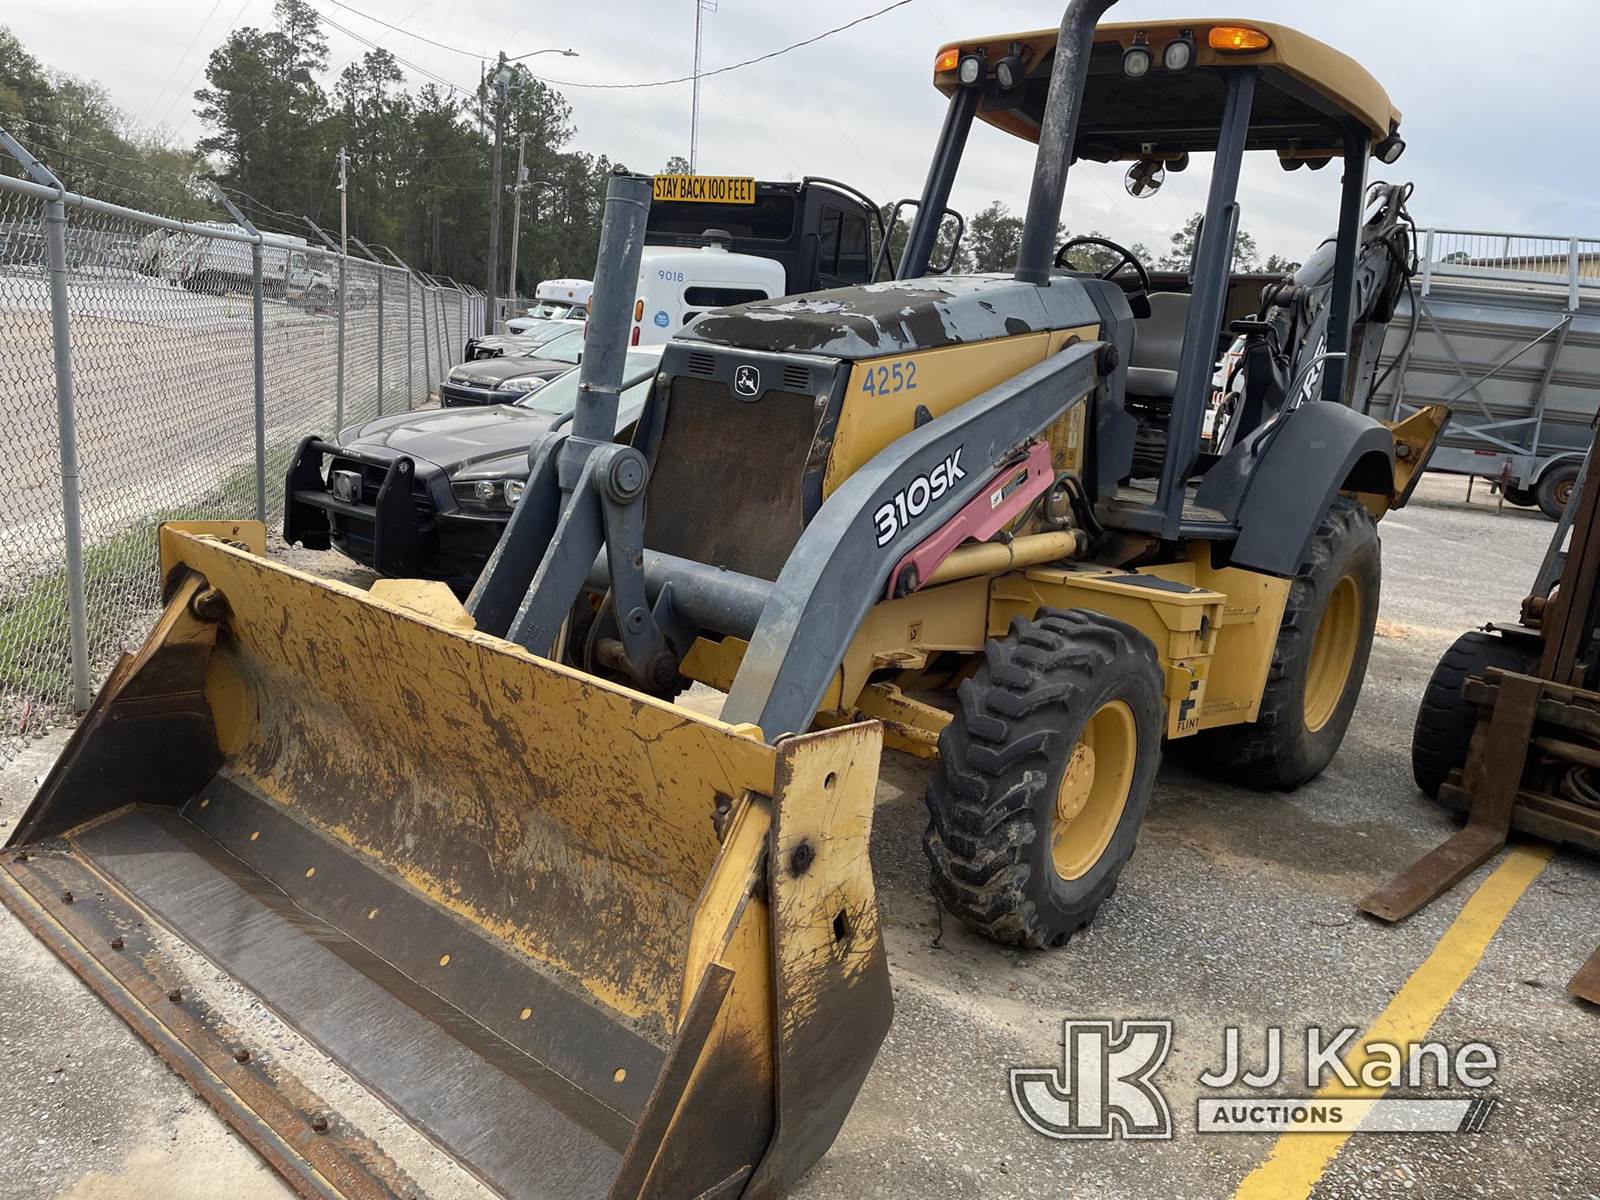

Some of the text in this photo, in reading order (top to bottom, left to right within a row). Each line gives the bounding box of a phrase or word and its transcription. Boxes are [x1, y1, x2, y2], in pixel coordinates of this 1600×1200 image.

[655, 177, 753, 201] STAY BACK 100 FEET
[658, 270, 684, 282] 9018
[863, 361, 917, 397] 4252
[873, 445, 967, 548] 310SK
[1177, 717, 1200, 732] FLINT
